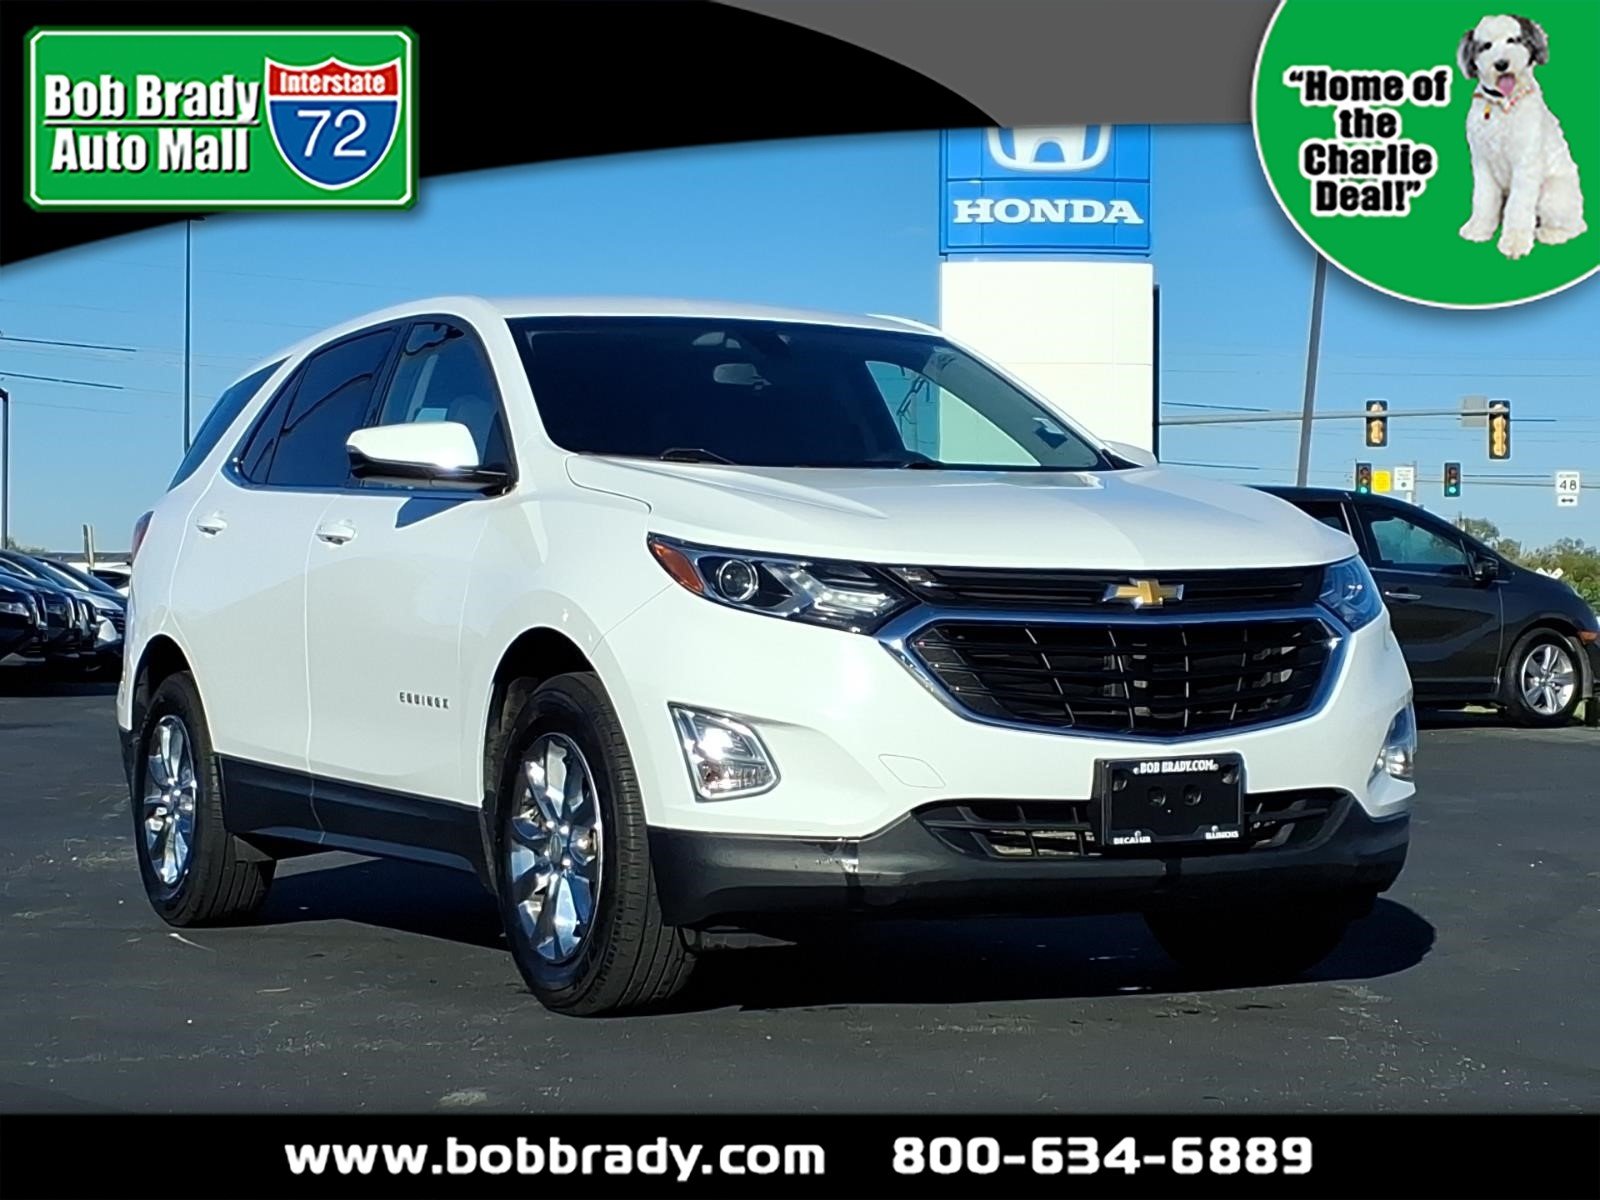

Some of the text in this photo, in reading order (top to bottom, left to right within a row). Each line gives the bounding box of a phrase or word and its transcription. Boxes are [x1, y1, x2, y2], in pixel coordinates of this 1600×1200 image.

[953, 198, 1145, 225] HONDA
[1559, 480, 1577, 490] 48
[399, 691, 449, 709] EQUINOX
[1140, 762, 1160, 774] BOB
